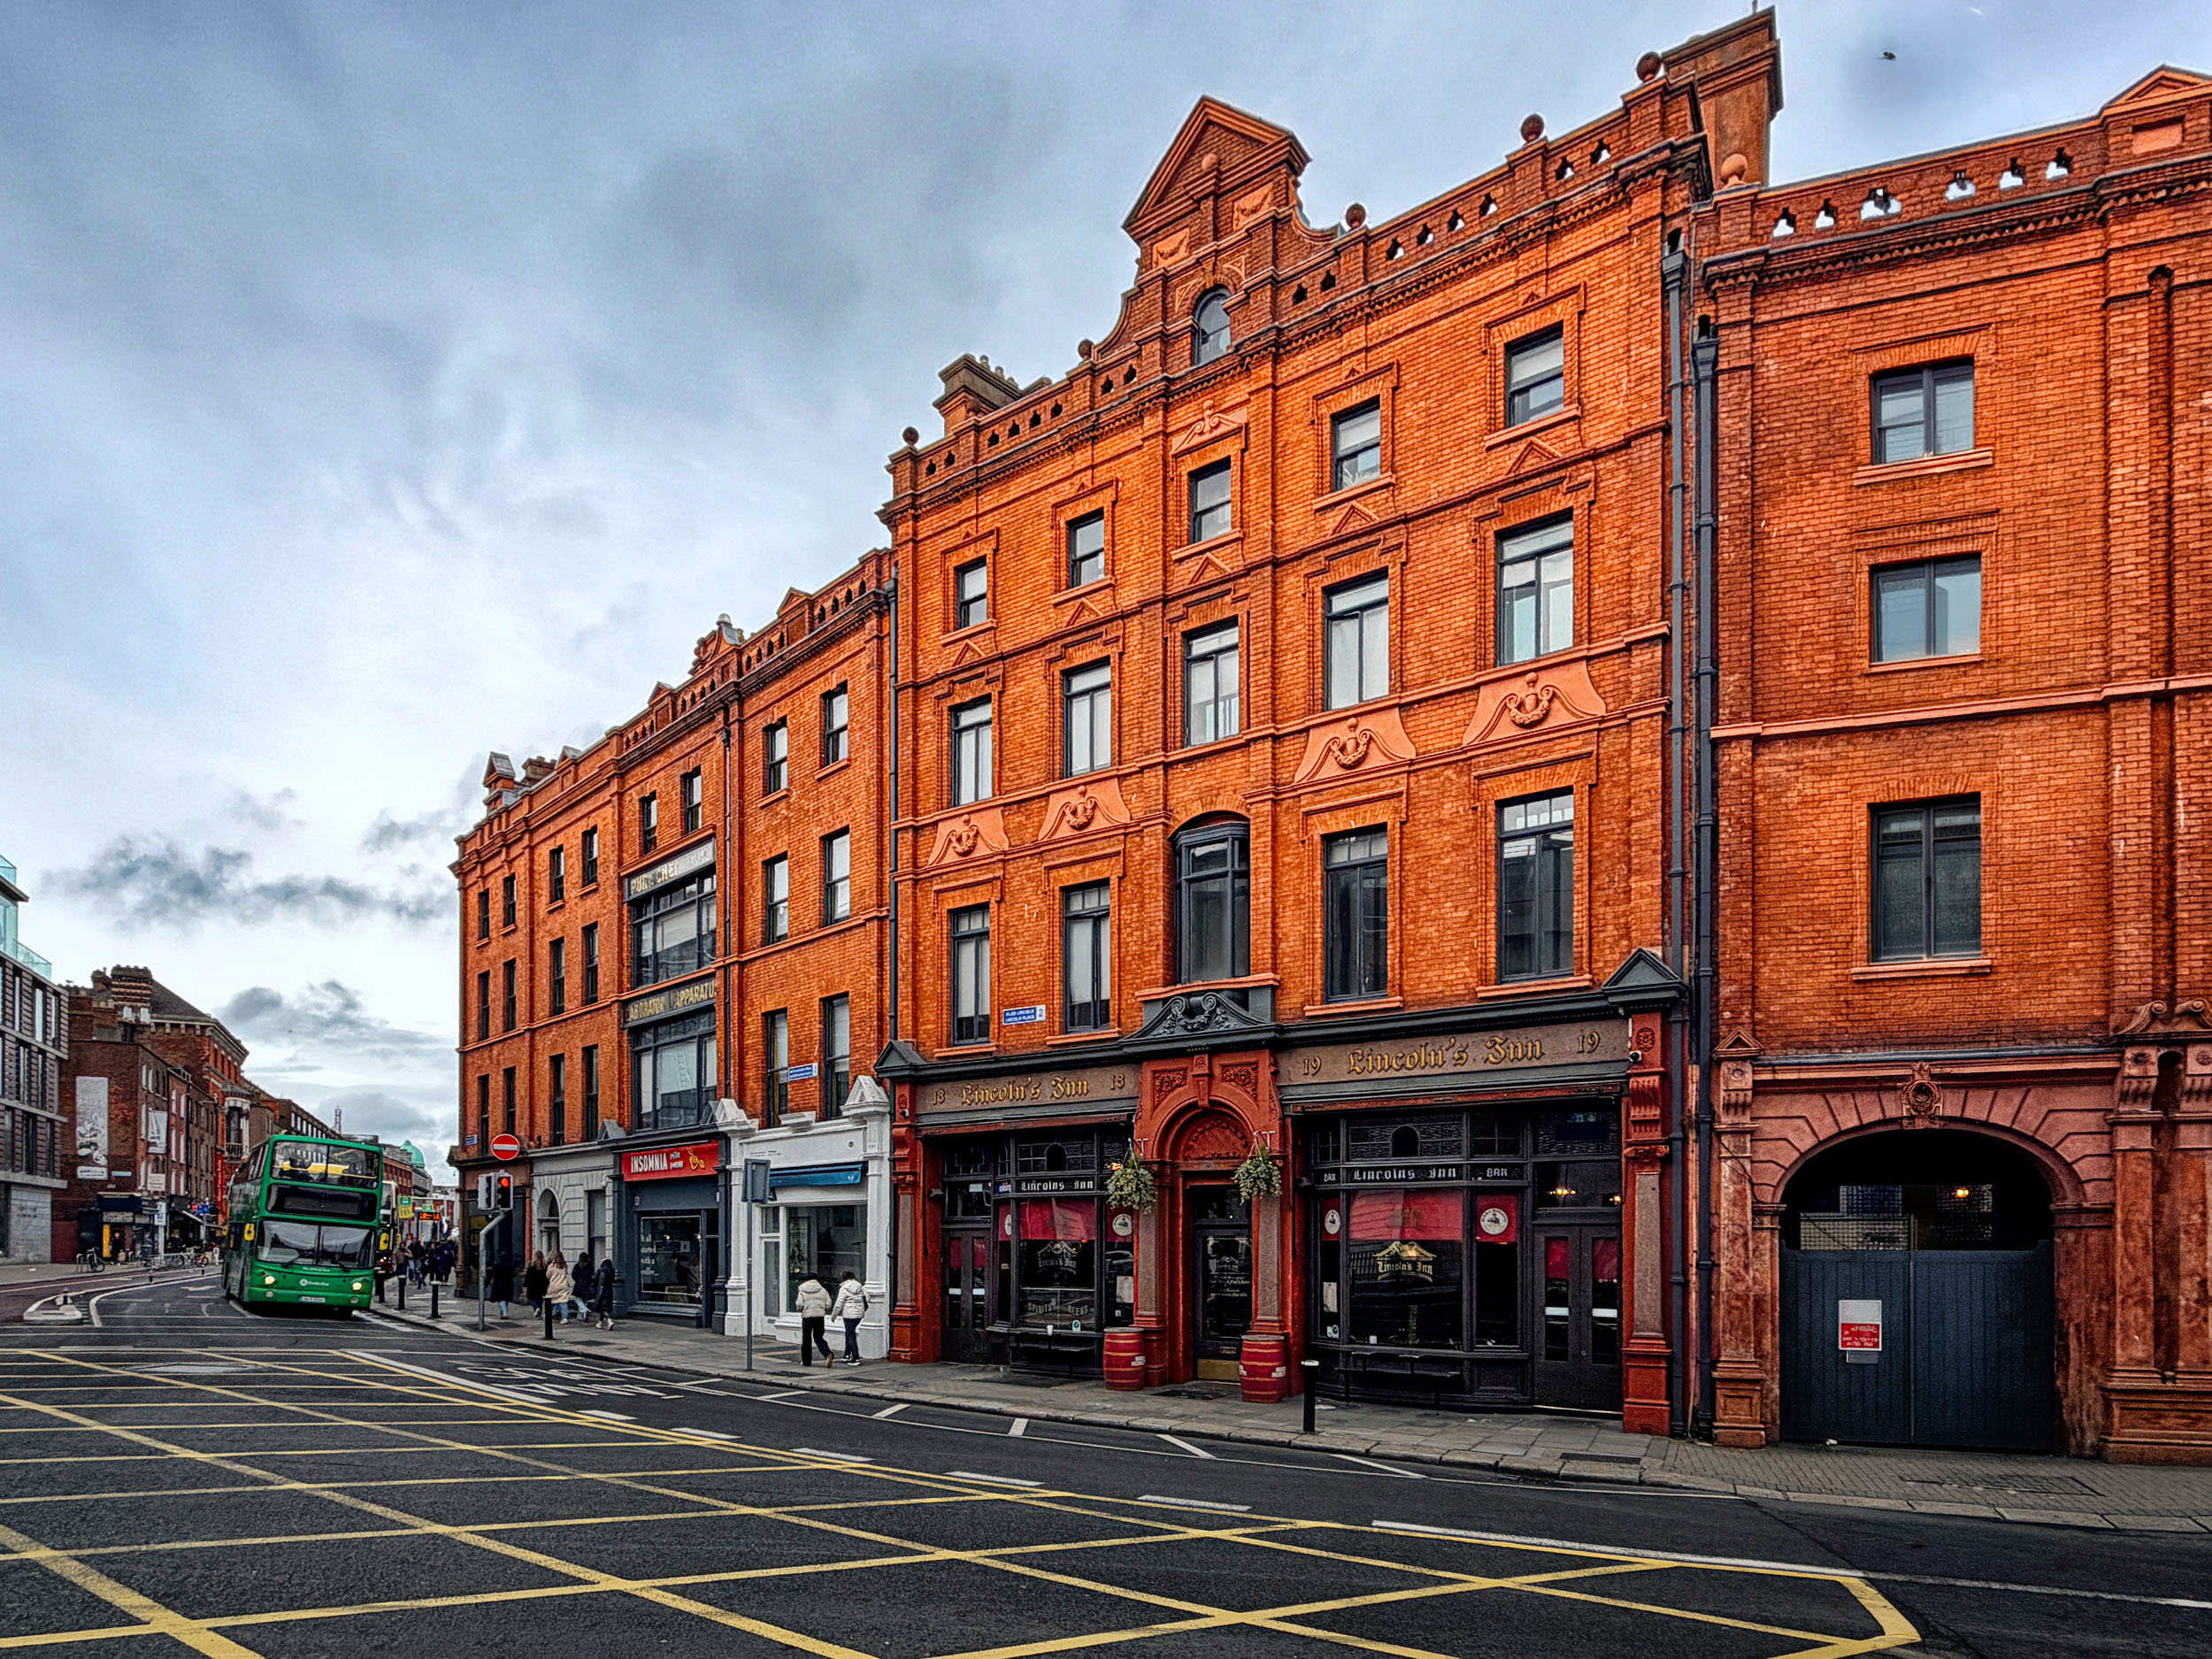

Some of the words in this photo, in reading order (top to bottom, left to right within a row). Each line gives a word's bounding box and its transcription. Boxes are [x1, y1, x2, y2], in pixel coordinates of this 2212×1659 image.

[1038, 1009, 1044, 1018] 2
[1302, 1055, 1322, 1076] 19
[1347, 1037, 1470, 1075] Lincoln's
[1483, 1035, 1545, 1064] Inn
[1576, 1032, 1600, 1054] 19
[933, 1090, 946, 1105] 18
[961, 1076, 1041, 1105] Lincoln's
[1050, 1076, 1089, 1099] Inn
[1110, 1072, 1125, 1090] 18
[631, 1153, 668, 1173] INSOMNIA
[1354, 1168, 1416, 1181] Lincolns
[1429, 1167, 1456, 1179] Inn
[1486, 1167, 1508, 1178] BAR
[1021, 1180, 1065, 1191] Lincolns
[1073, 1179, 1094, 1189] Inn
[1377, 1261, 1413, 1272] Lincoln's
[1417, 1261, 1432, 1274] Inn
